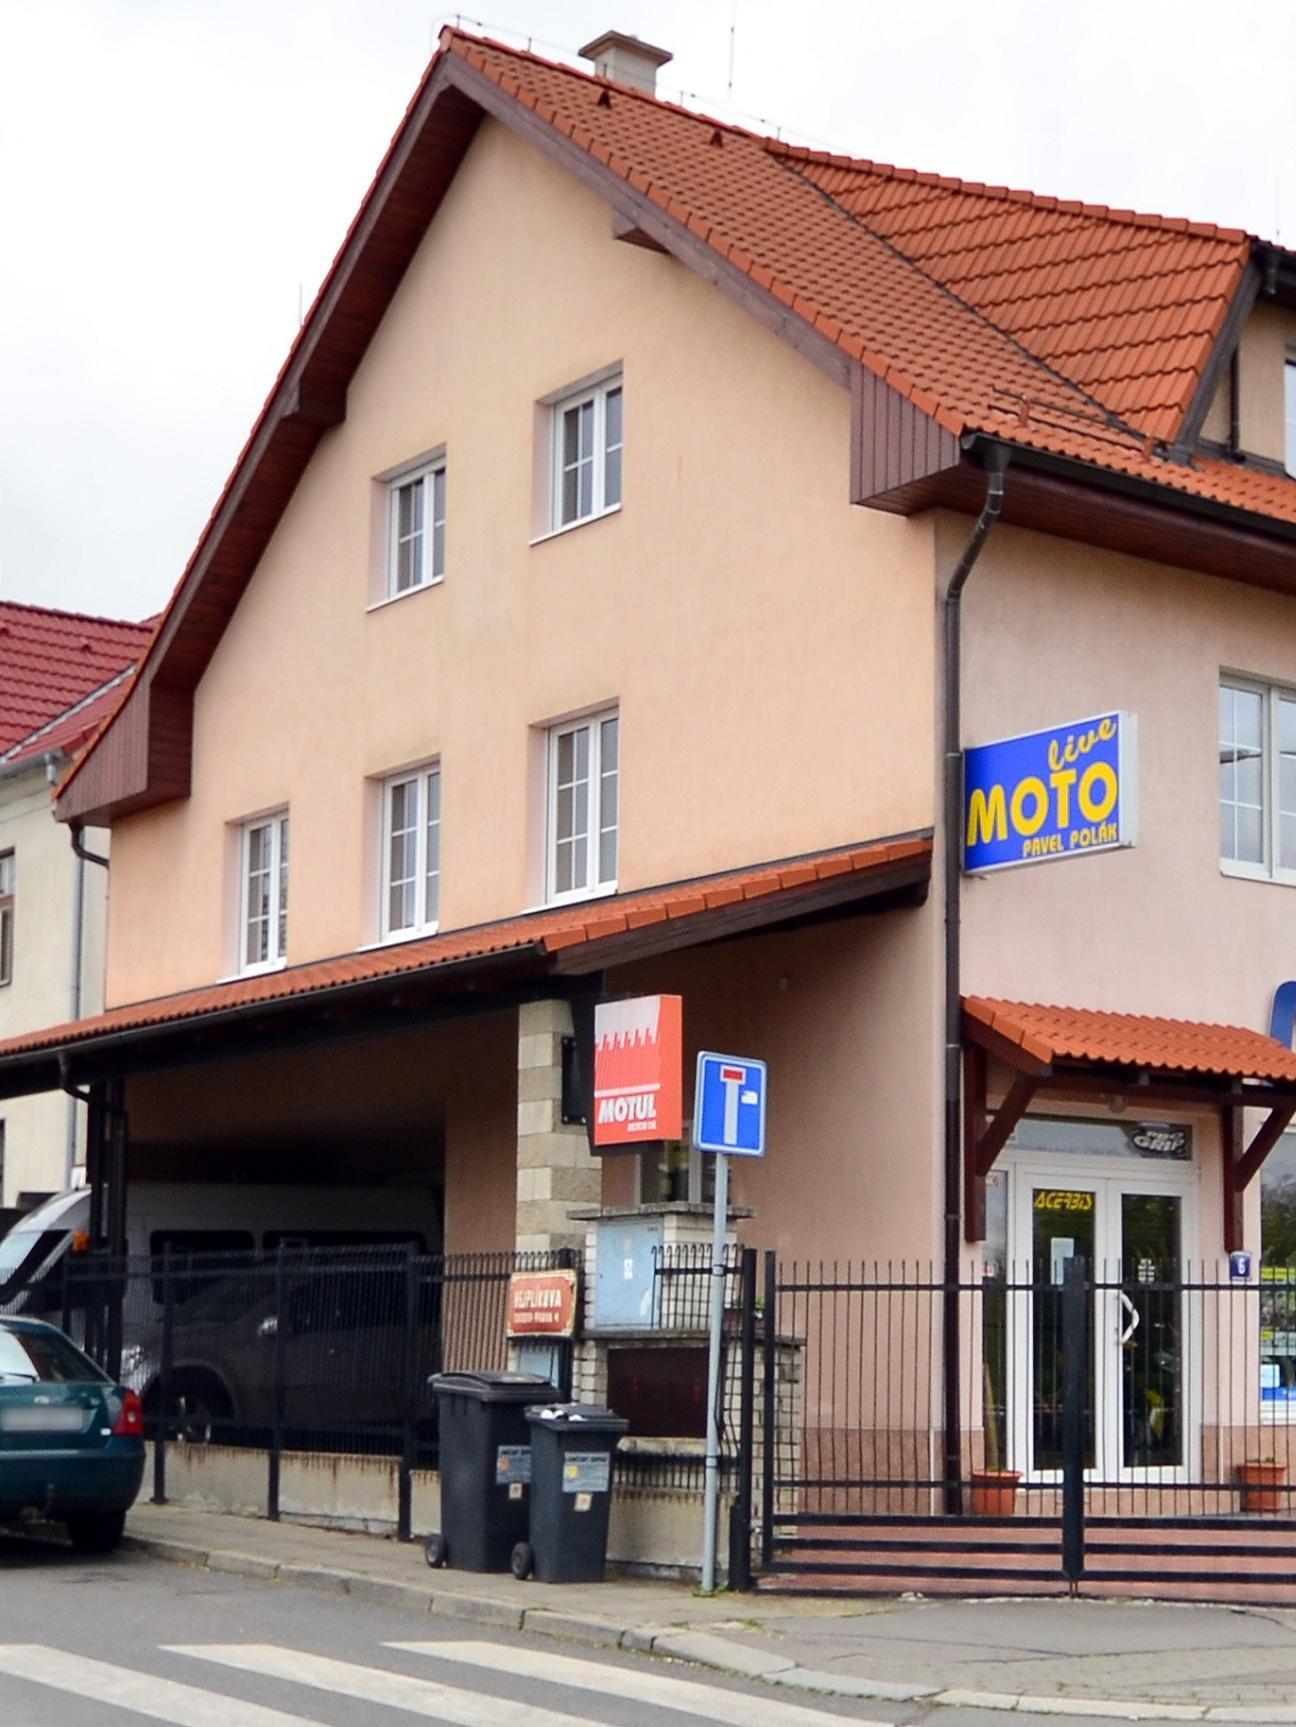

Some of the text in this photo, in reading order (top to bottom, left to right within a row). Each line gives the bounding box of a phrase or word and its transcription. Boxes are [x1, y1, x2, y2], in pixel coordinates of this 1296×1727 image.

[1048, 719, 1117, 770] live
[968, 762, 1118, 846] MOTO
[1023, 822, 1117, 858] PAVEL POLÁK
[598, 1094, 656, 1124] MOTUL
[1237, 1258, 1246, 1275] 6
